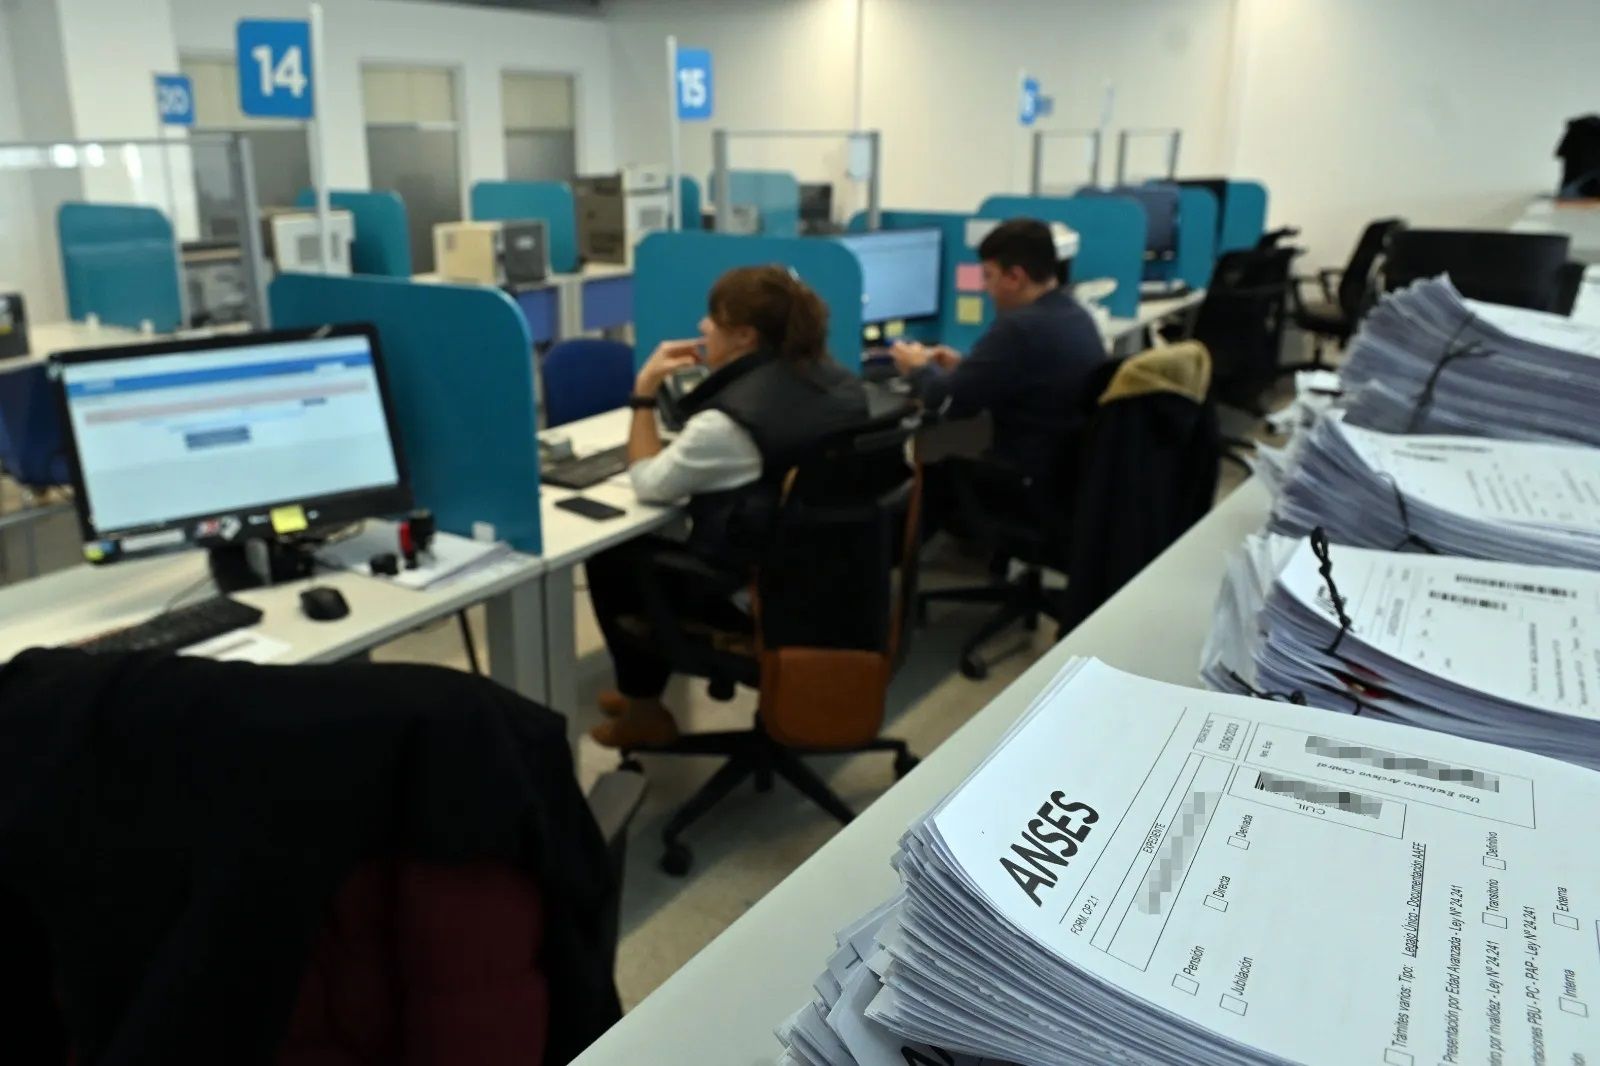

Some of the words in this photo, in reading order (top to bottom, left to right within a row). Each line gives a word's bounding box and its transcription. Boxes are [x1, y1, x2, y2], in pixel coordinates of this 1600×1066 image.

[252, 45, 307, 98] 14
[679, 68, 706, 107] 15
[1316, 762, 1355, 775] Central
[1360, 771, 1401, 784] Archivo
[1404, 781, 1455, 797] Exclusivo
[1459, 794, 1480, 804] Uso
[1143, 822, 1166, 854] EXPEDIENTE
[1236, 814, 1253, 838] Derivada
[999, 790, 1099, 908] ANSES
[1411, 841, 1424, 860] AAFF
[1486, 831, 1498, 857] Definitivo
[1213, 875, 1231, 898] Directa
[1406, 860, 1421, 907] Documentación
[1486, 879, 1499, 911] Transitorio
[1450, 885, 1463, 907] 24.241
[1556, 886, 1569, 912] Externa
[1070, 913, 1088, 936] FORM.
[1401, 912, 1417, 931] Único
[1449, 917, 1465, 931] Ley
[1523, 905, 1537, 930] 24.241
[1401, 932, 1419, 958] Legajo
[1447, 936, 1461, 974] Avanzada
[1486, 940, 1500, 967] 24.241
[1524, 941, 1541, 955] Ley
[1183, 945, 1205, 976] Pensión
[1525, 961, 1539, 980] PAP
[1231, 956, 1253, 996] Jubilación
[1398, 964, 1415, 983] Tipo:
[1445, 973, 1460, 995] Edad
[1563, 968, 1577, 998] Interna
[1397, 984, 1411, 1011] varios:
[1485, 978, 1504, 994] Ley
[1525, 986, 1540, 1000] PC
[1448, 994, 1462, 1011] por
[1486, 999, 1501, 1036] invalidez
[1527, 1004, 1542, 1026] PBU
[1392, 1012, 1409, 1047] Trámites
[1442, 1011, 1459, 1064] Presentación
[1489, 1035, 1505, 1052] por
